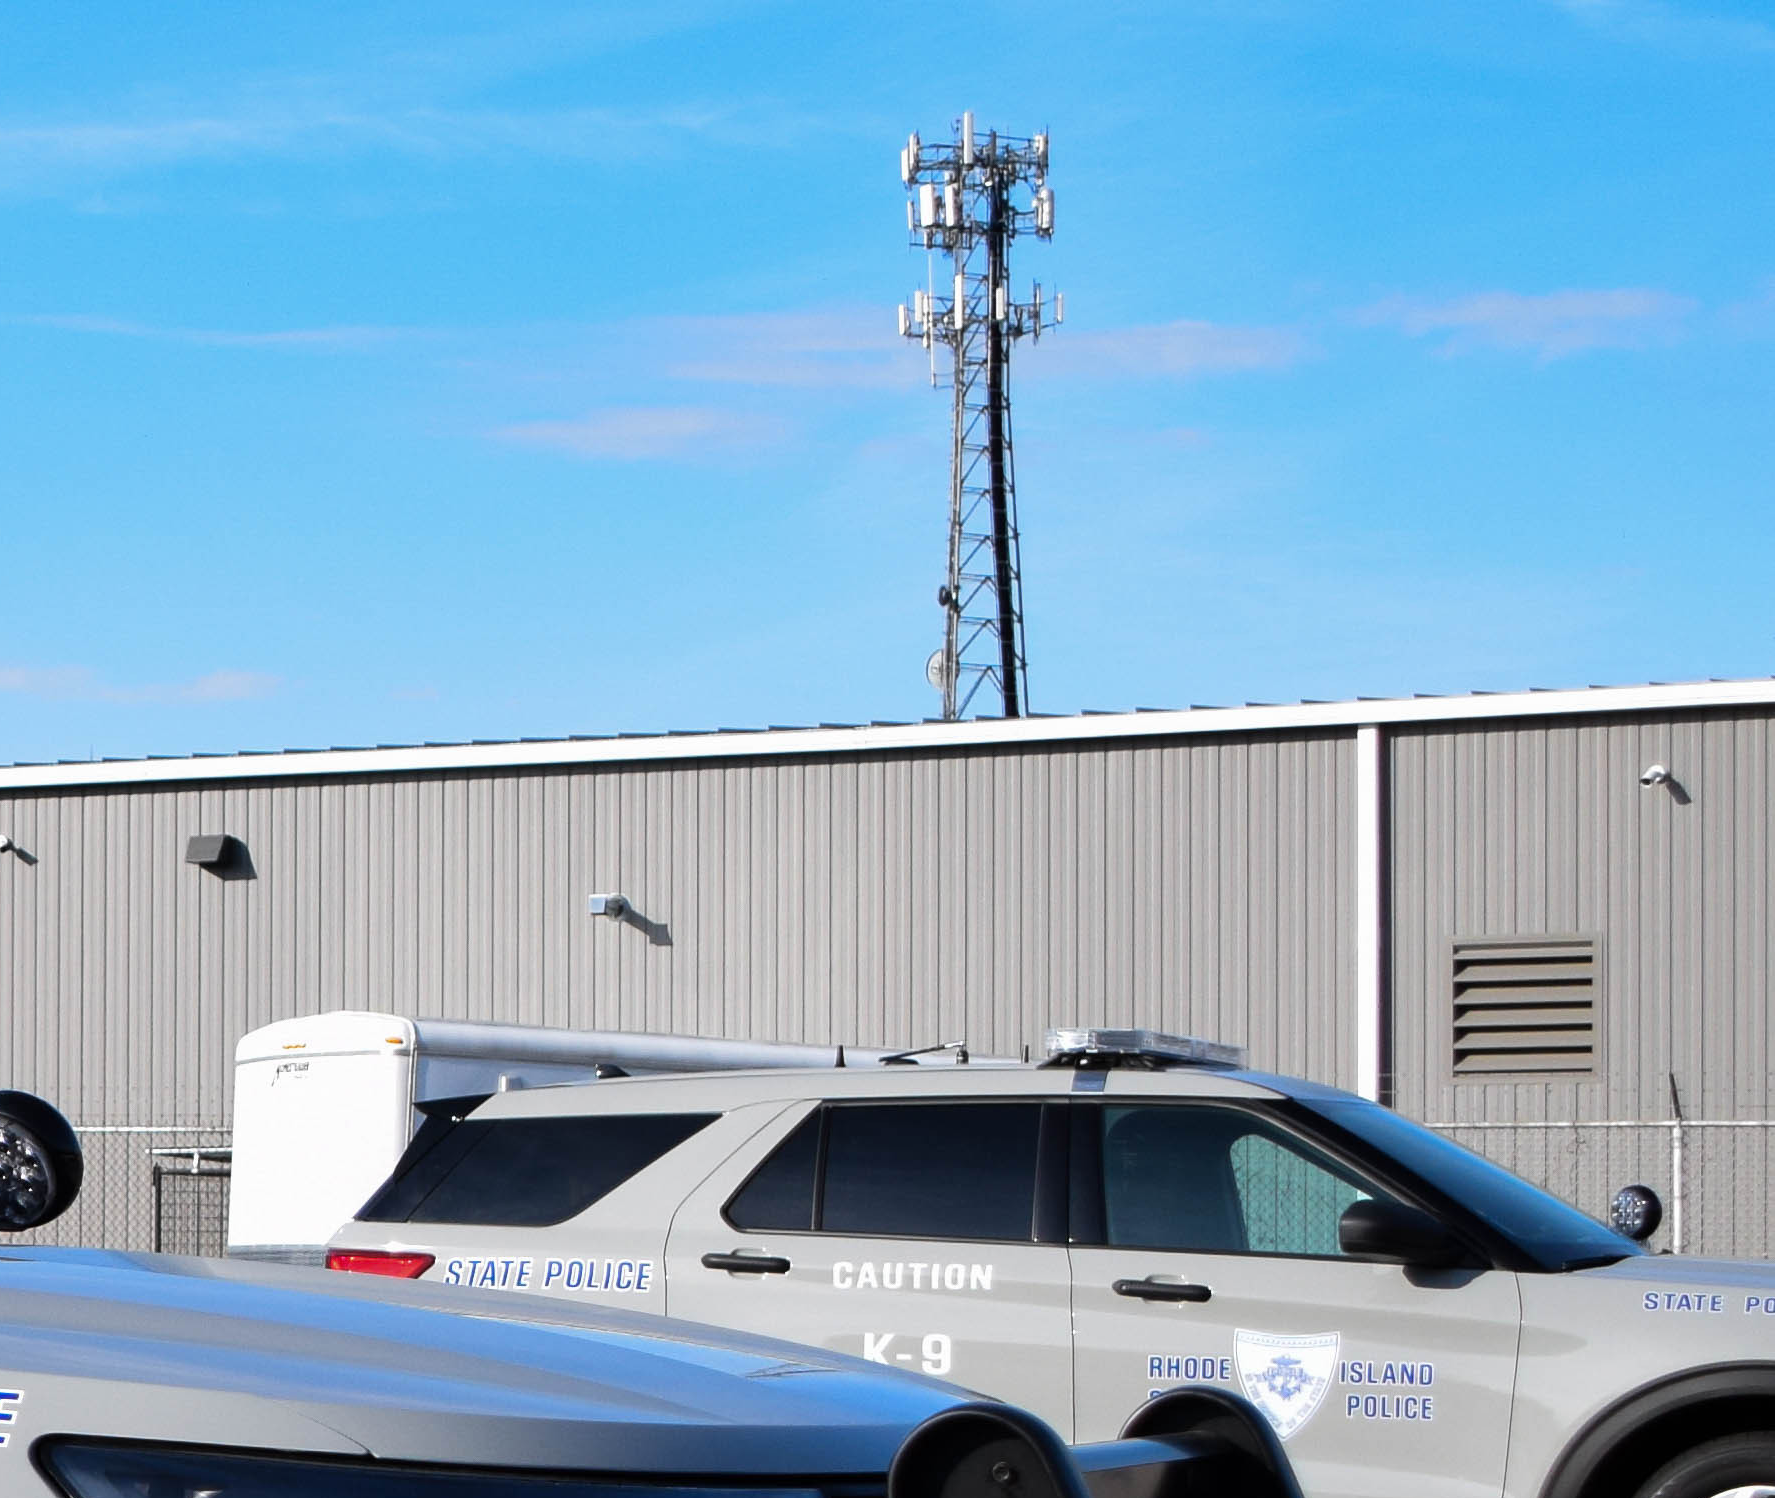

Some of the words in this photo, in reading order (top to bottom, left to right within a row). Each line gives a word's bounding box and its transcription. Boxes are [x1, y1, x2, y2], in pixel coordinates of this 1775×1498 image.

[444, 1257, 532, 1288] STATE
[543, 1257, 653, 1293] POLICE
[833, 1261, 993, 1290] CAUTION
[1643, 1291, 1722, 1313] STATE
[863, 1332, 951, 1375] K-9
[1148, 1355, 1232, 1381] RHODE
[1339, 1360, 1434, 1387] ISLAND
[1346, 1394, 1433, 1420] POLICE
